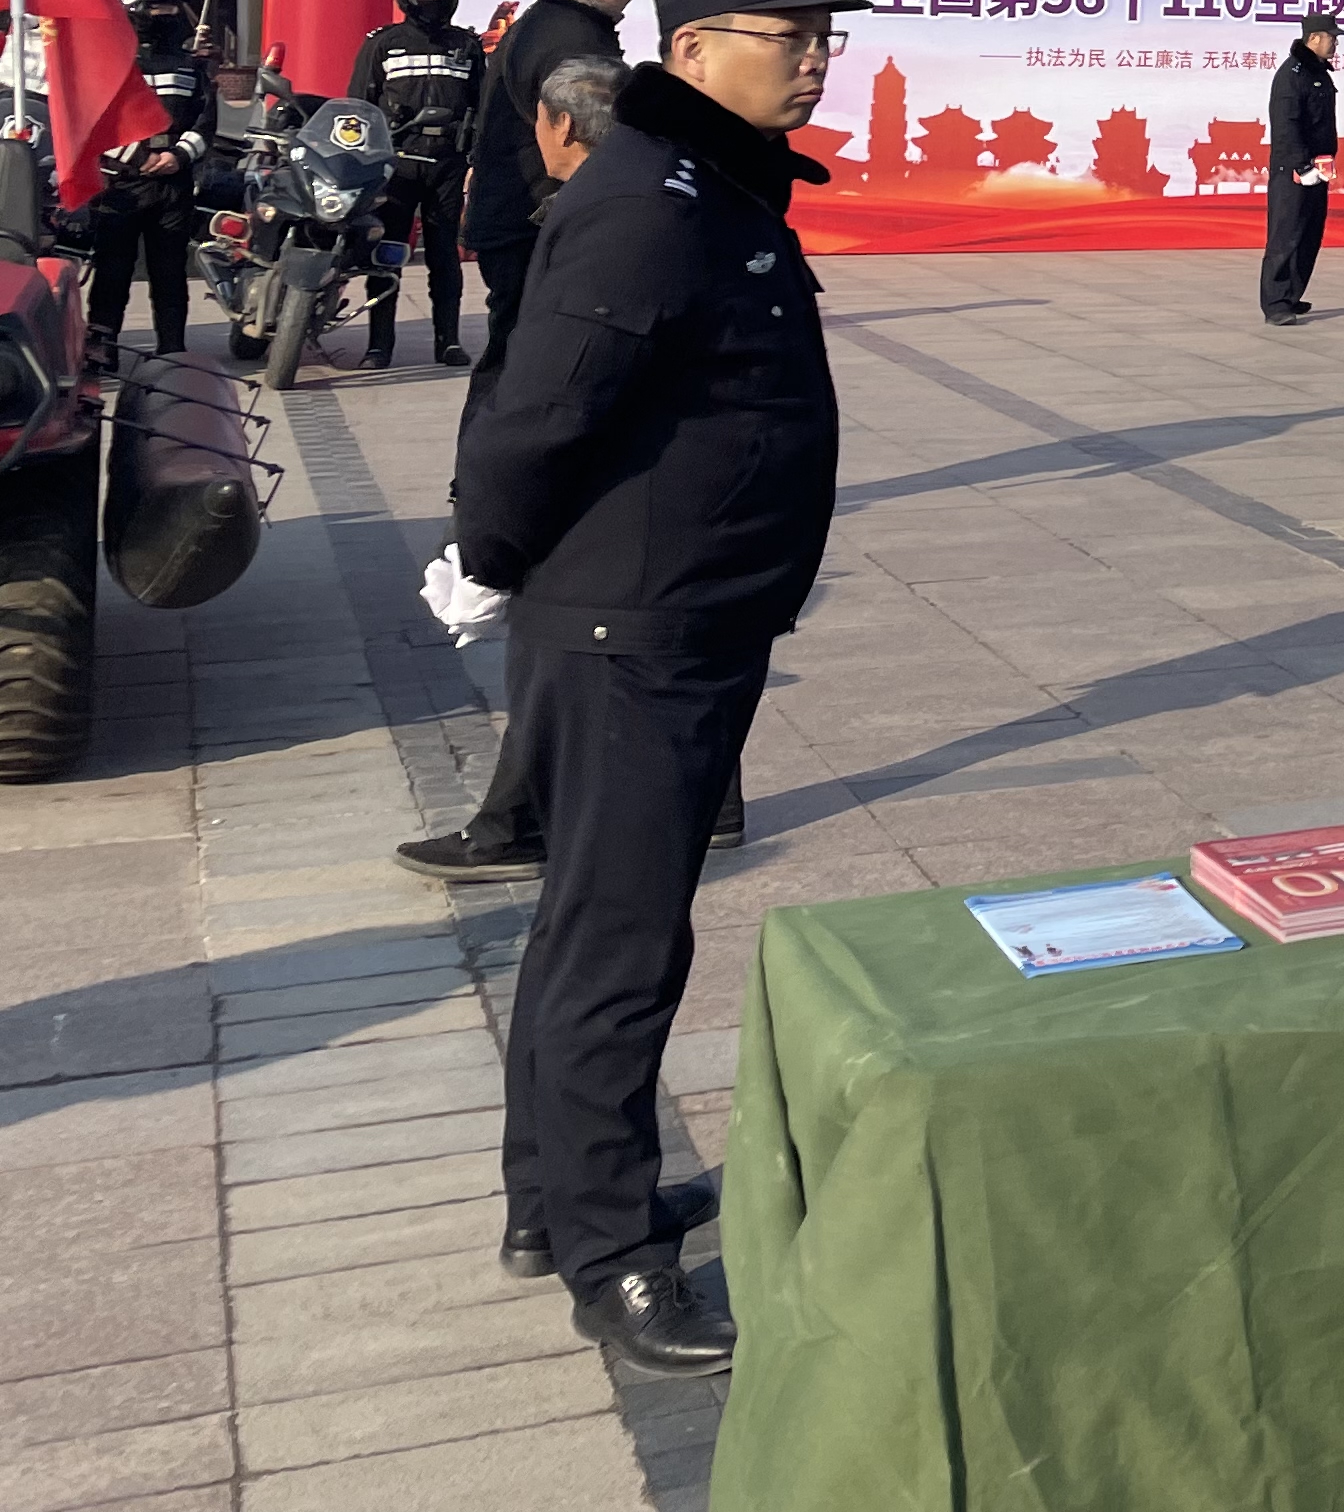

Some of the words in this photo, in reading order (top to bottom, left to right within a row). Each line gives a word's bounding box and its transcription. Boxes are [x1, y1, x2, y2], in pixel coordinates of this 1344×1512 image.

[1026, 47, 1107, 68] 执法为民
[1116, 49, 1194, 69] 公正廉洁
[1202, 51, 1277, 71] 无私奉献
